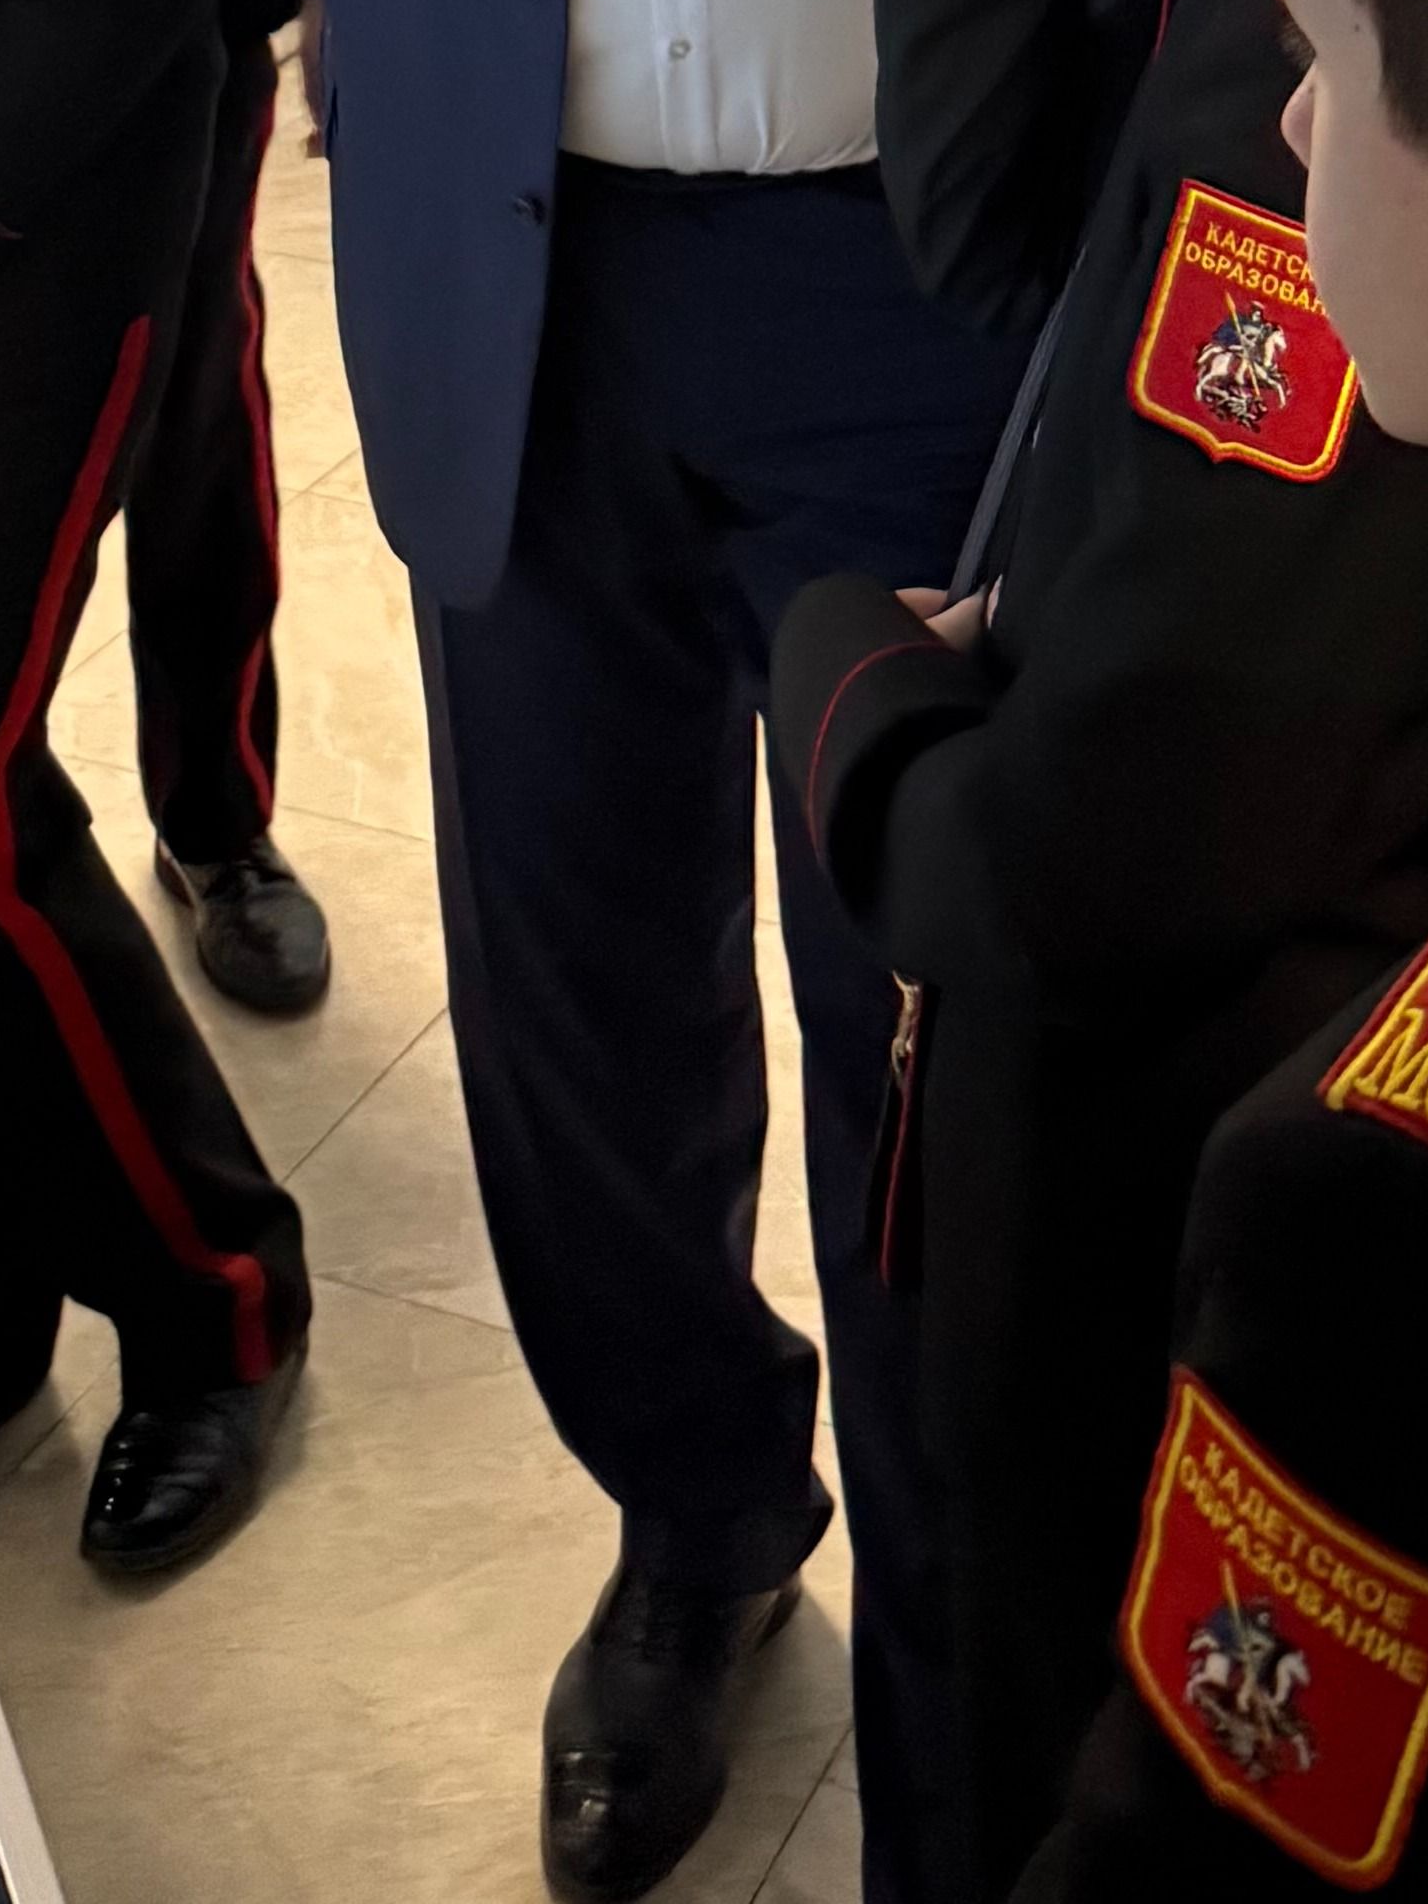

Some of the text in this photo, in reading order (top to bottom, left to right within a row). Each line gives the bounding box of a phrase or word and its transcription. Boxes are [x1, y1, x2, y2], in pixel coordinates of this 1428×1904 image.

[1205, 221, 1315, 282] КАДЕТСК
[1179, 1454, 1428, 1684] ОБРАЗОВАНИЕ
[1204, 1442, 1412, 1630] КАДЕТСКОЕ
